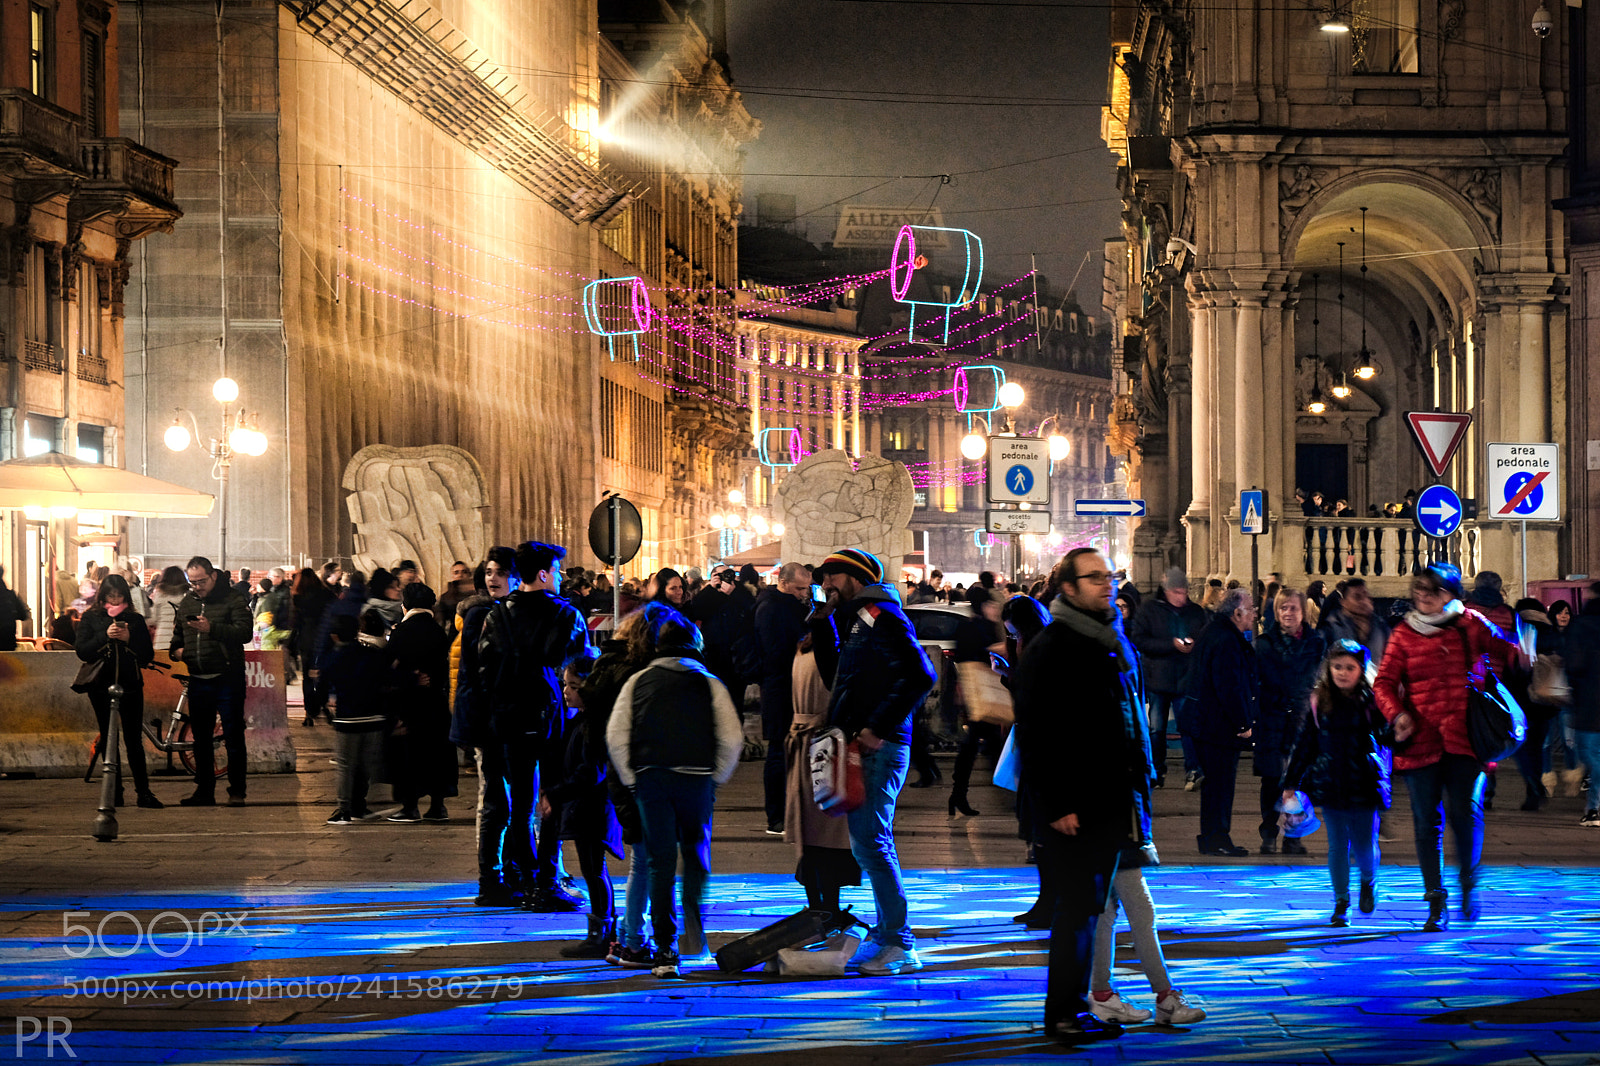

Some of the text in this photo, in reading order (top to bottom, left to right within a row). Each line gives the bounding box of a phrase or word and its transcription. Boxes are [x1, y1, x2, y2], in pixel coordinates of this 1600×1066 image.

[846, 212, 937, 227] ALLEANZA
[1510, 447, 1535, 455] area
[1001, 452, 1039, 461] pedonale
[1496, 457, 1550, 468] pedonale
